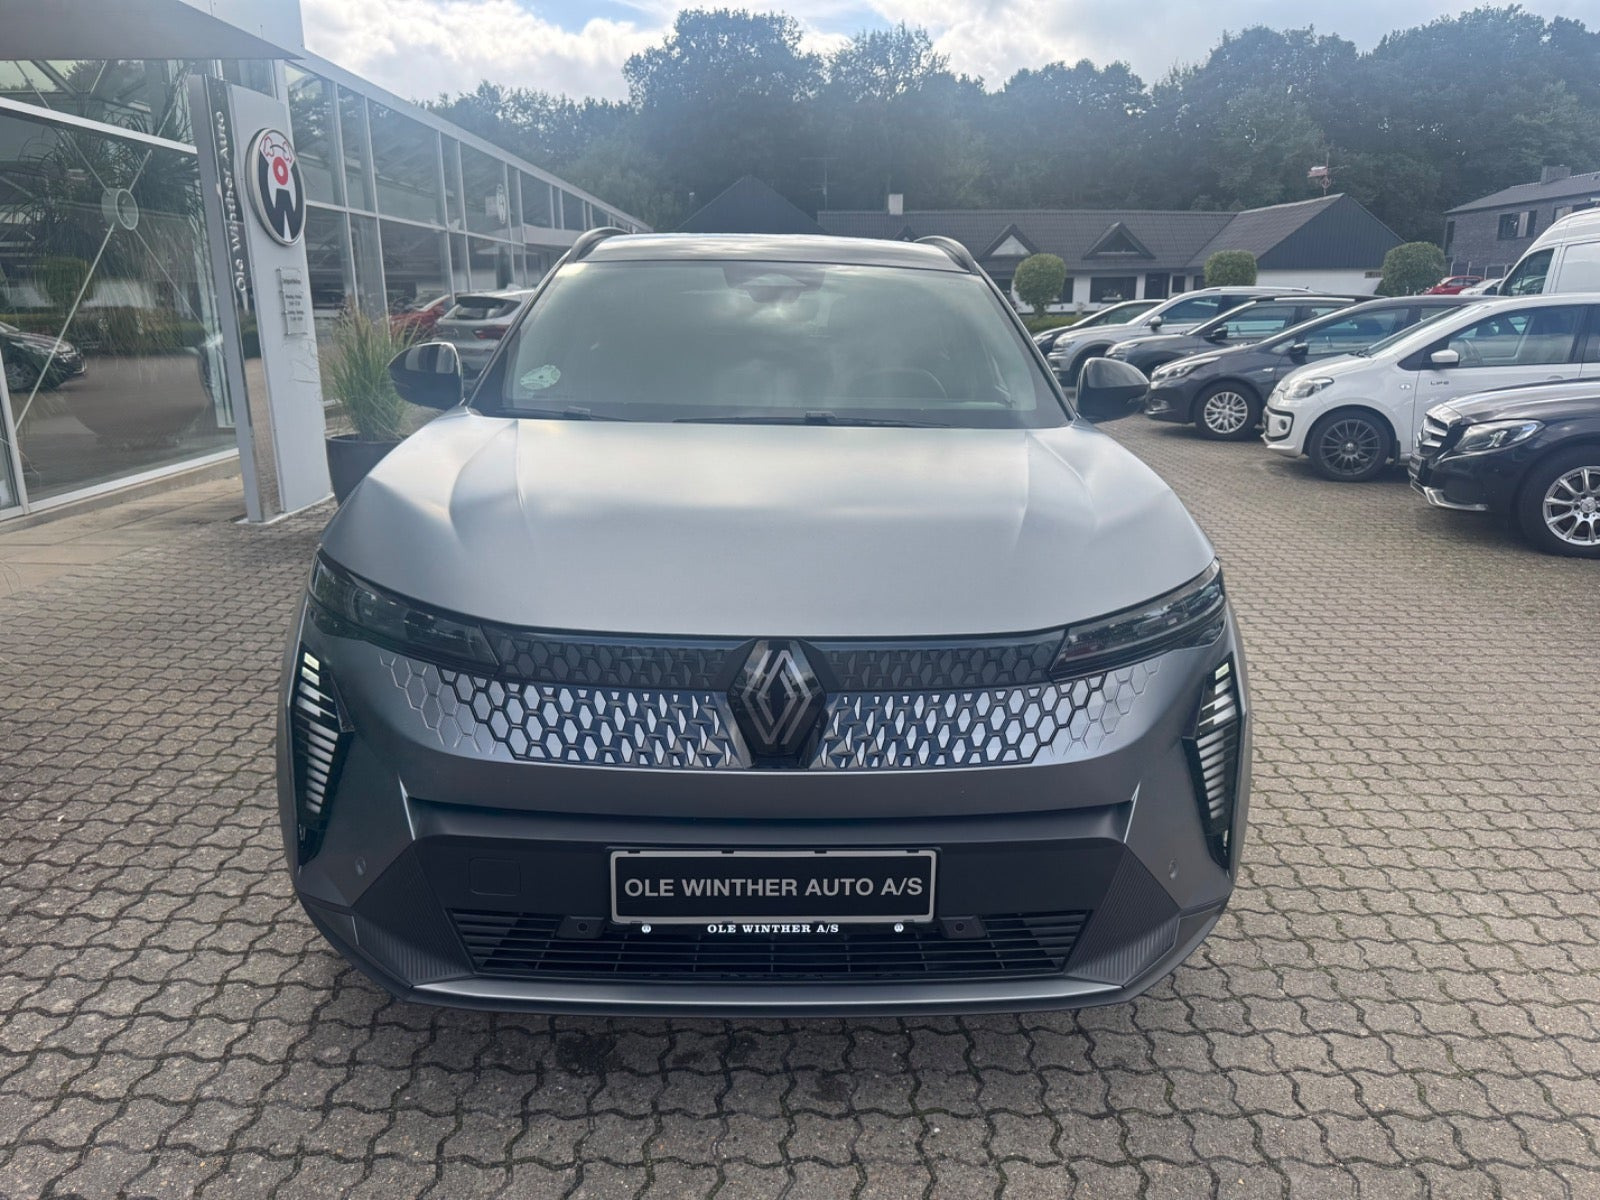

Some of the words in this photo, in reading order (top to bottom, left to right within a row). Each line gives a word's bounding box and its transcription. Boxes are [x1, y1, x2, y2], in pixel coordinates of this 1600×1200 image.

[215, 111, 230, 163] Auto
[222, 168, 242, 252] Winther
[235, 258, 247, 292] Ole
[624, 878, 675, 897] OLE
[681, 878, 798, 897] WINTHER
[804, 877, 874, 897] AUTO
[880, 877, 923, 896] A/S
[707, 923, 737, 934] OLE
[742, 923, 812, 934] WINTHER
[816, 923, 839, 934] A/S
